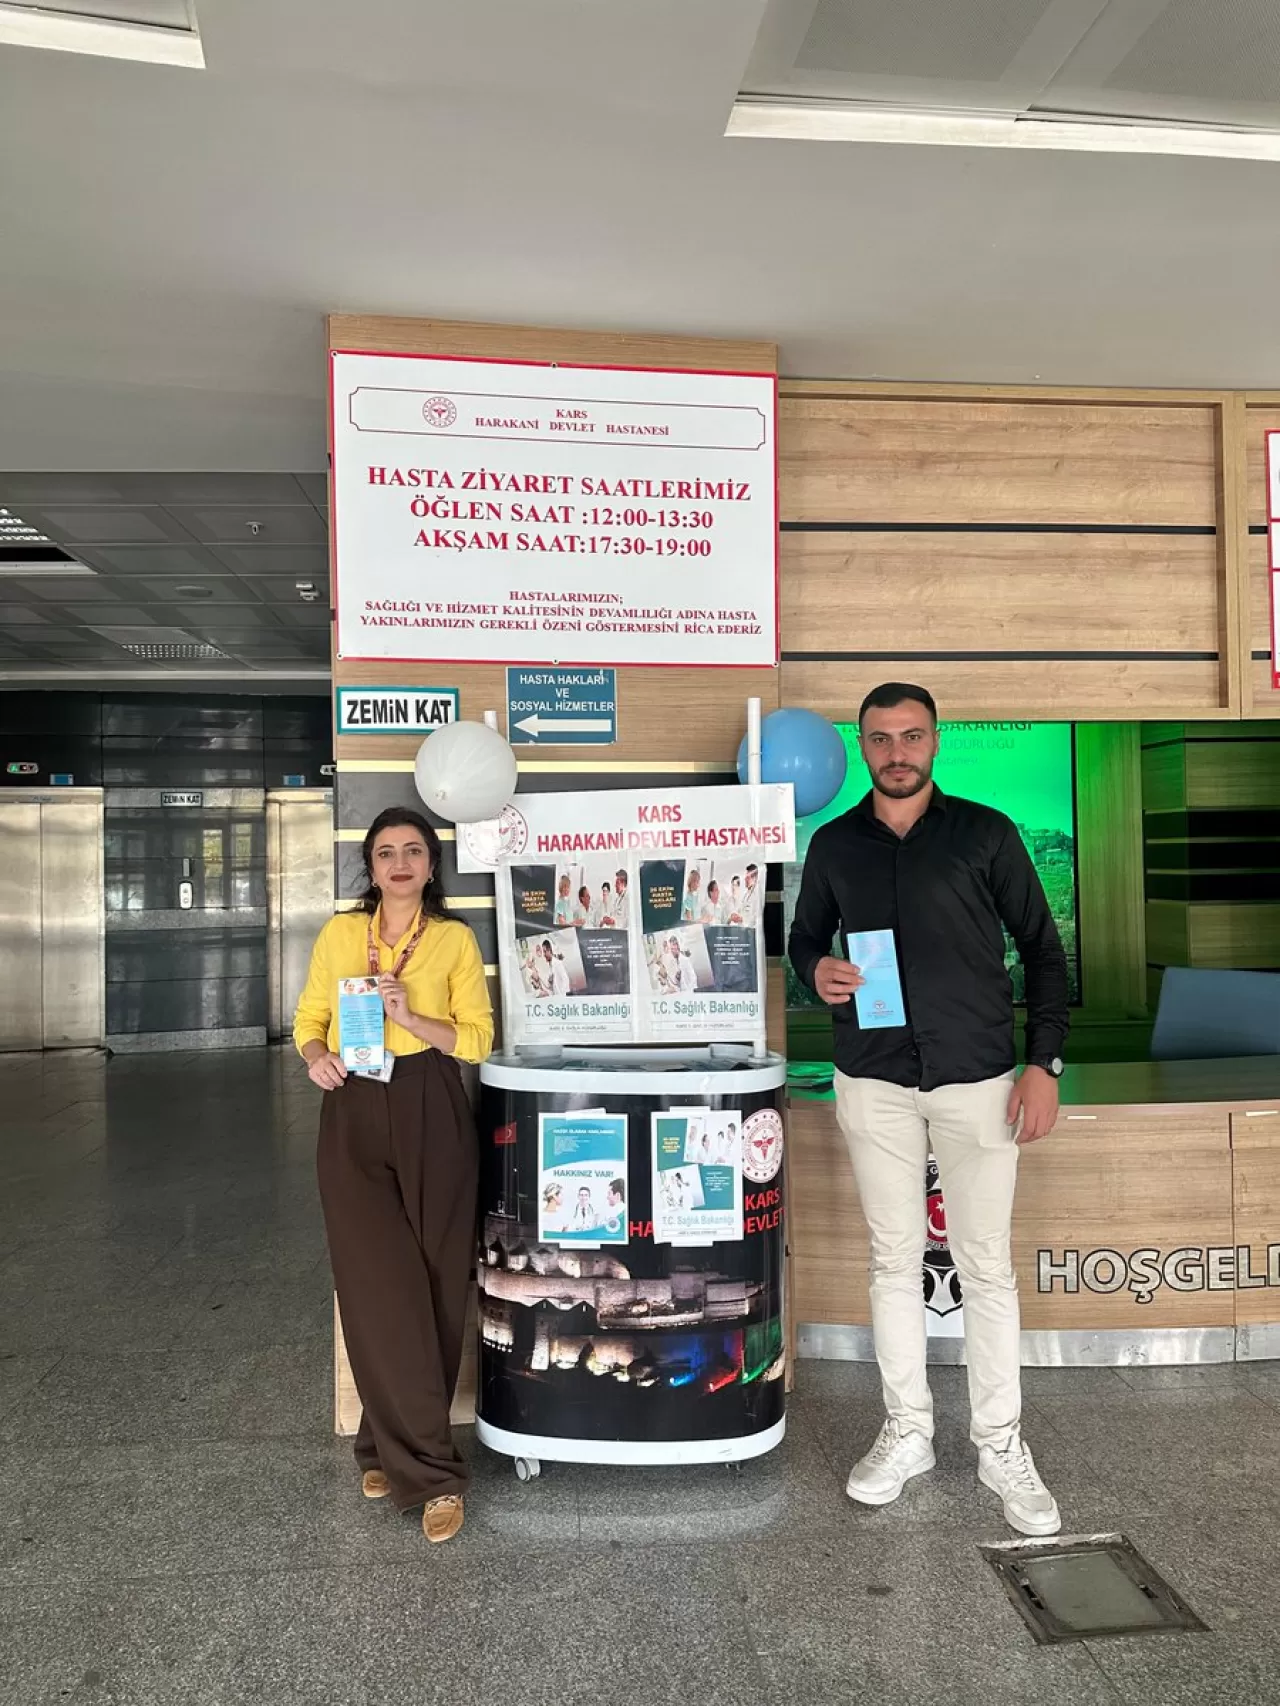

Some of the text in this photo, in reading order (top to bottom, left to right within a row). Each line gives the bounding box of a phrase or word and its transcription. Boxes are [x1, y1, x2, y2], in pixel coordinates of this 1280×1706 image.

[556, 409, 587, 419] KARS
[475, 417, 669, 436] HARAKANİ DEVLET HASTANESİ
[368, 466, 751, 501] HASTA ZİYARET SAATLERİMİZ
[410, 494, 713, 529] ÖĞLEN SAAT :12:00-13:30
[413, 529, 712, 556] AKŞAM SAAT:17:30-19:00
[509, 591, 624, 605] HASTALARIMIZIN;
[365, 600, 757, 621] SAĞLIĞI VE HİZMET KALİTESİNİN DEVAMLILIĞI ADINA HASTA
[360, 615, 762, 635] YAKINLARIMIZIN GEREKLİ ÖZENİ GÖSTERMESİNİ RİCA EDERİZ
[520, 674, 604, 685] HASTA HAKLARI
[555, 687, 570, 698] VE
[415, 699, 451, 724] KAT
[510, 699, 614, 712] SOSYAL HİZMETLER
[638, 804, 682, 823] KARS
[537, 828, 623, 852] HARAKANİ
[628, 829, 690, 848] DEVLET
[694, 823, 786, 847] HASTANESİ
[525, 1002, 631, 1020] T.C. Sağlık Bakanlığı
[652, 1000, 759, 1017] T.C. Sağlık Bakanlığı
[553, 1169, 614, 1178] HAKKINIZ VAR!
[744, 1187, 780, 1211] KARS
[743, 1208, 785, 1235] EVLET
